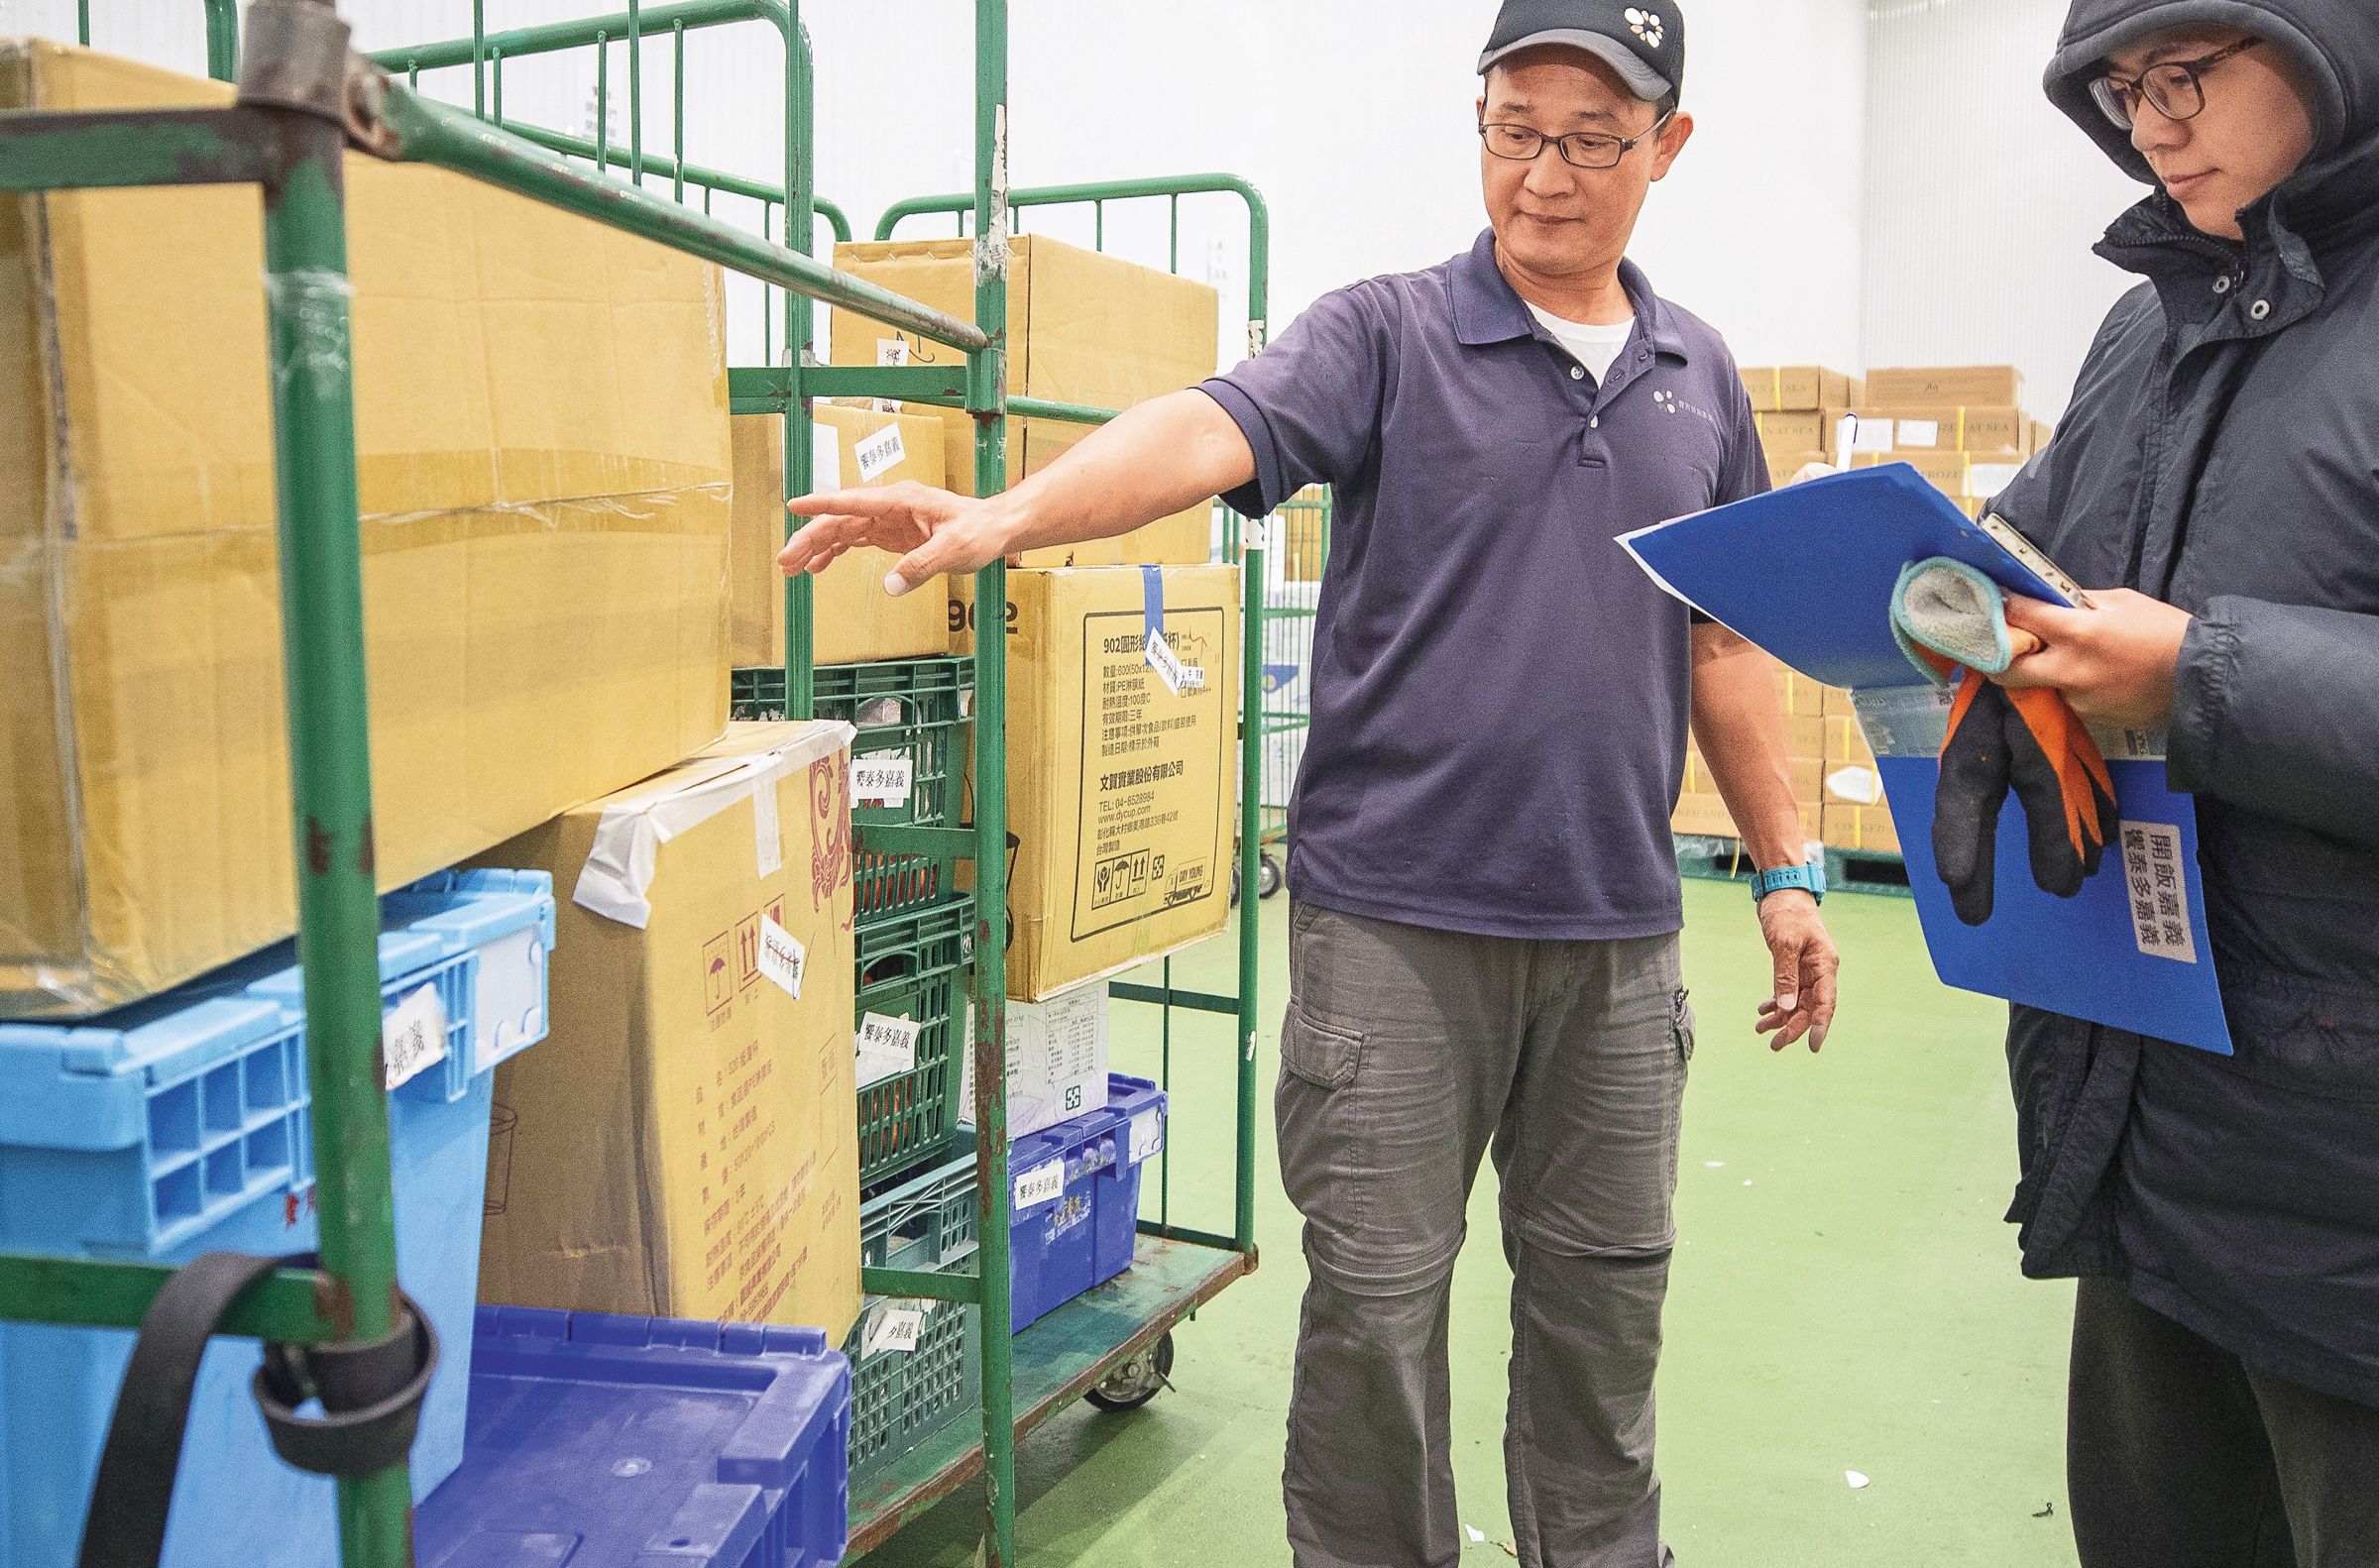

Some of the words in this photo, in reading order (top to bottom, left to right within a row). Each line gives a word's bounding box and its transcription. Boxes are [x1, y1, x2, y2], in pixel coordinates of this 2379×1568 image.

[856, 769, 905, 789] 饗泰多嘉義
[1099, 760, 1184, 792] 文賀實業股份有限公司
[1097, 805, 1151, 824] www.dycup.com
[2124, 829, 2160, 947] 饗泰多嘉義
[2150, 834, 2185, 947] 開飯嘉義
[864, 1023, 910, 1050] 饗泰多嘉義
